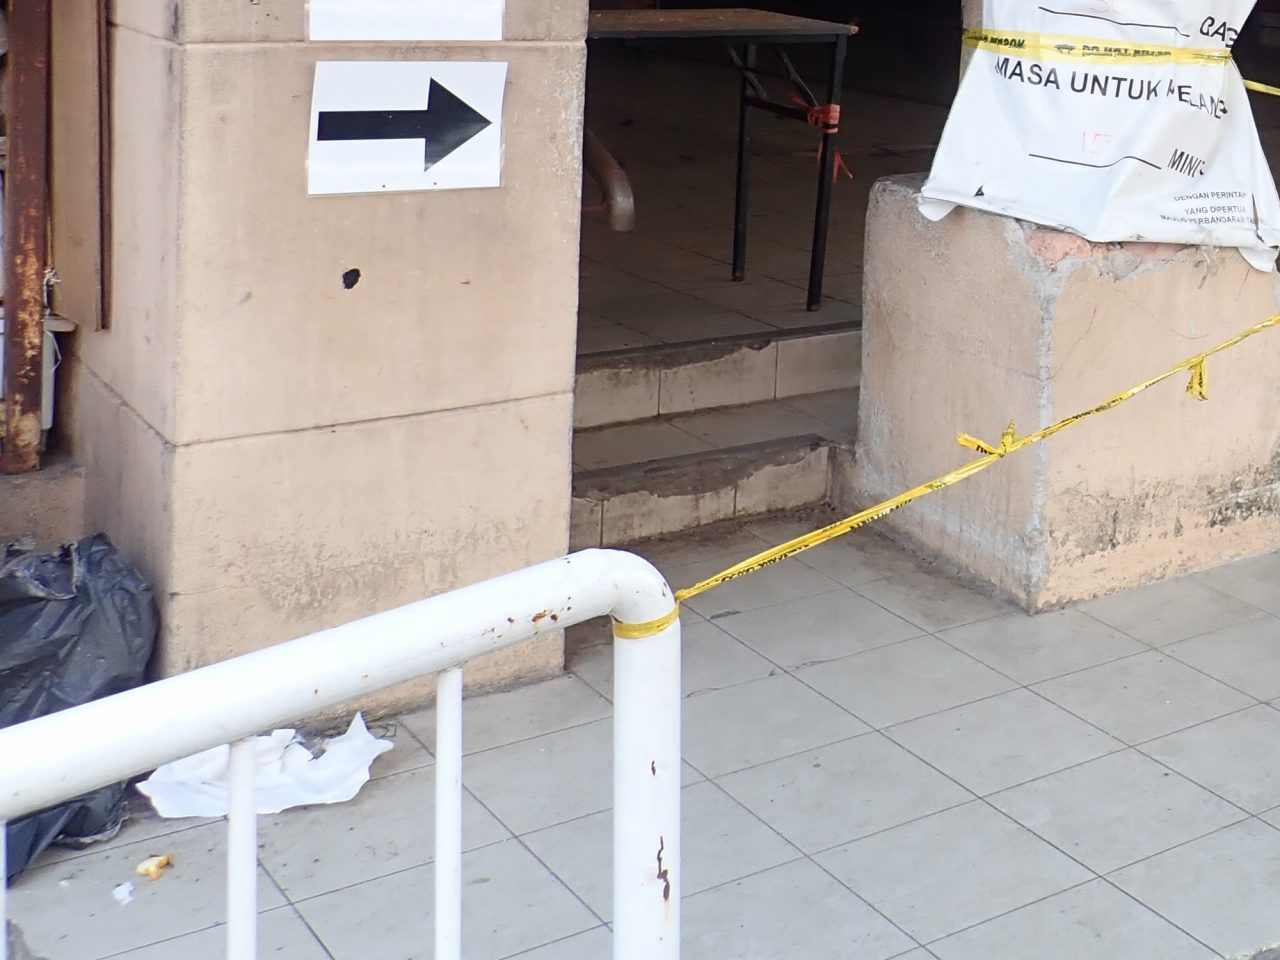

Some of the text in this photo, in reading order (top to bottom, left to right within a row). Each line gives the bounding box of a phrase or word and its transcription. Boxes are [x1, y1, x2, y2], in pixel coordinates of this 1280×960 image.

[994, 56, 1060, 90] MASA
[1070, 71, 1161, 101] UNTUK
[1185, 207, 1208, 216] YANG
